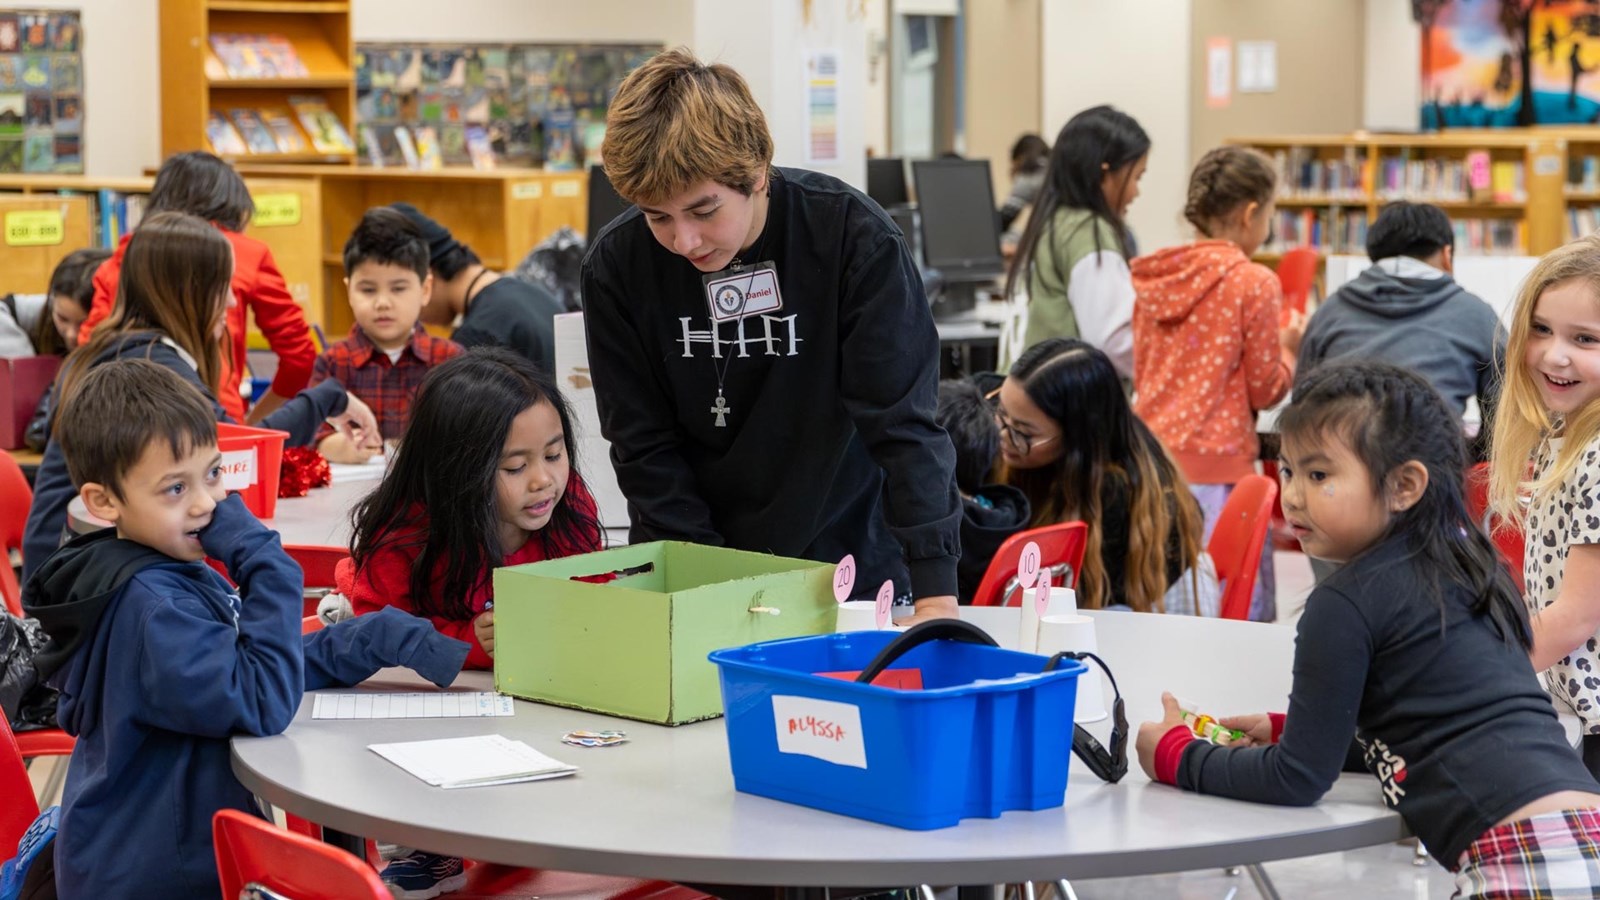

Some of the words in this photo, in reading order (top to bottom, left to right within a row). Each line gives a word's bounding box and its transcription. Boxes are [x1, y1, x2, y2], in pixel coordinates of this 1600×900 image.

[745, 287, 772, 300] Daniel
[1024, 552, 1036, 575] 10
[837, 565, 851, 588] 20
[879, 589, 890, 615] 15
[1041, 581, 1049, 602] 5
[788, 715, 846, 742] ALYSSA
